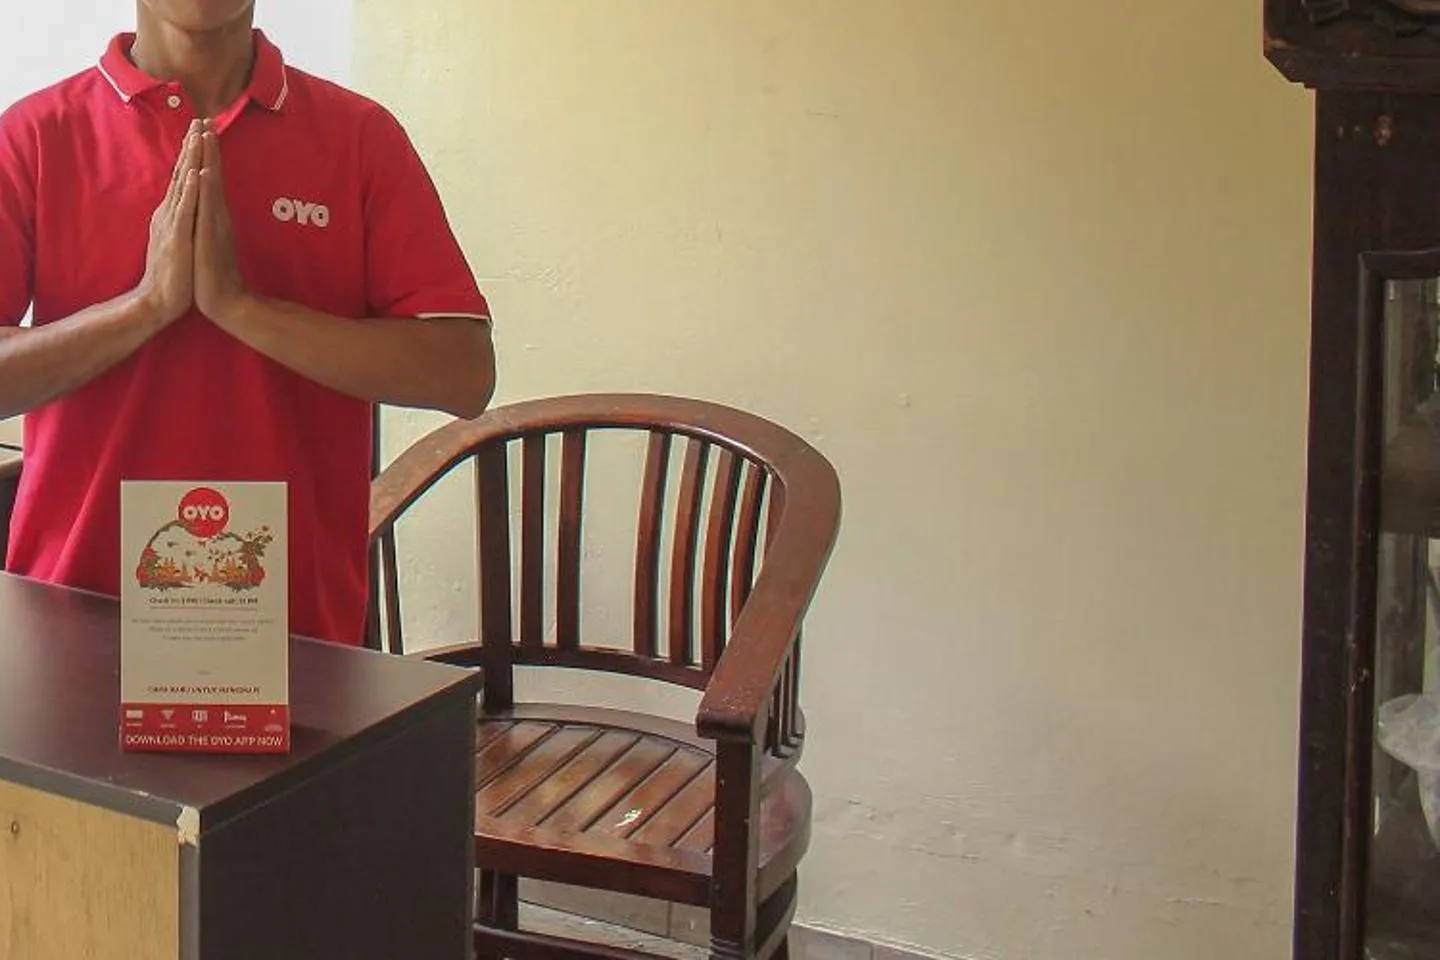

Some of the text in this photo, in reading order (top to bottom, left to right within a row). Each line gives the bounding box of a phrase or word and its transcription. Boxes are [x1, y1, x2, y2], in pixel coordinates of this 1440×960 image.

[272, 197, 329, 227] OYO
[183, 504, 224, 521] OYO
[126, 734, 284, 746] DOWNLOAD THE OYO APP NOW
